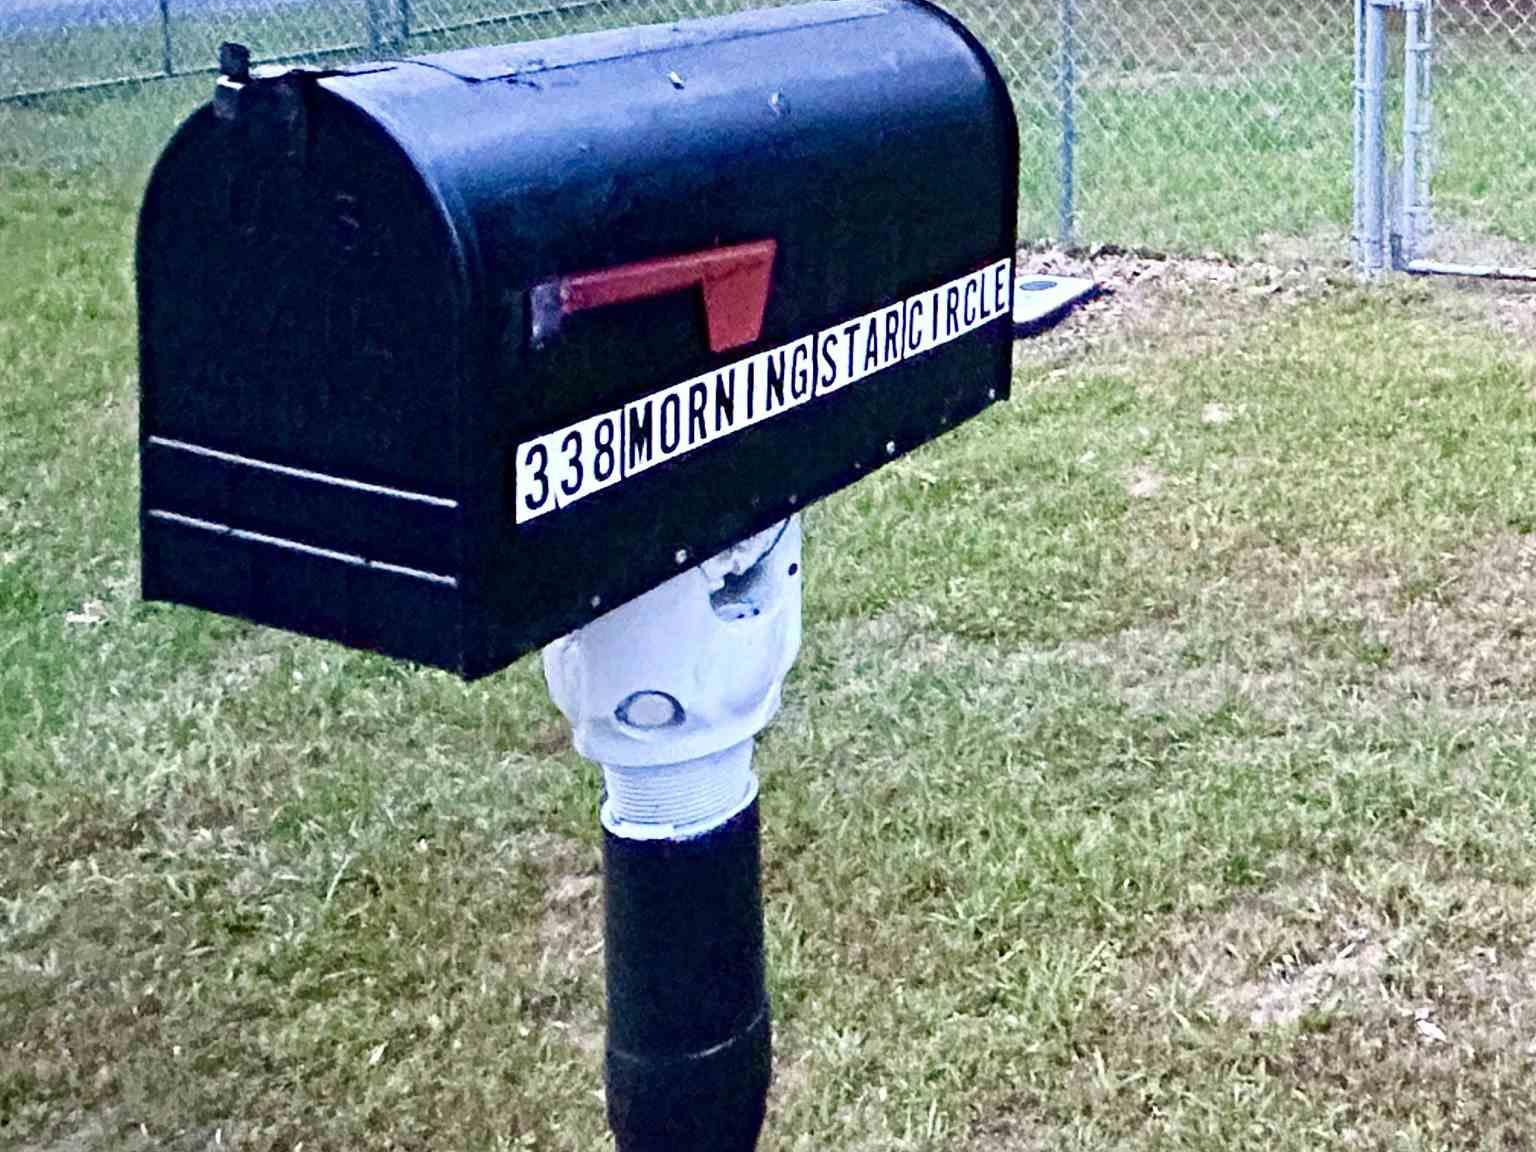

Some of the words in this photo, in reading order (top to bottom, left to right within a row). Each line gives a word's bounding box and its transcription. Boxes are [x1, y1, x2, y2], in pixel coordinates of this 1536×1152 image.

[524, 420, 616, 511] 338
[628, 343, 809, 469] MORNING
[820, 309, 903, 389] STAR
[908, 263, 1006, 352] CIRCLE
